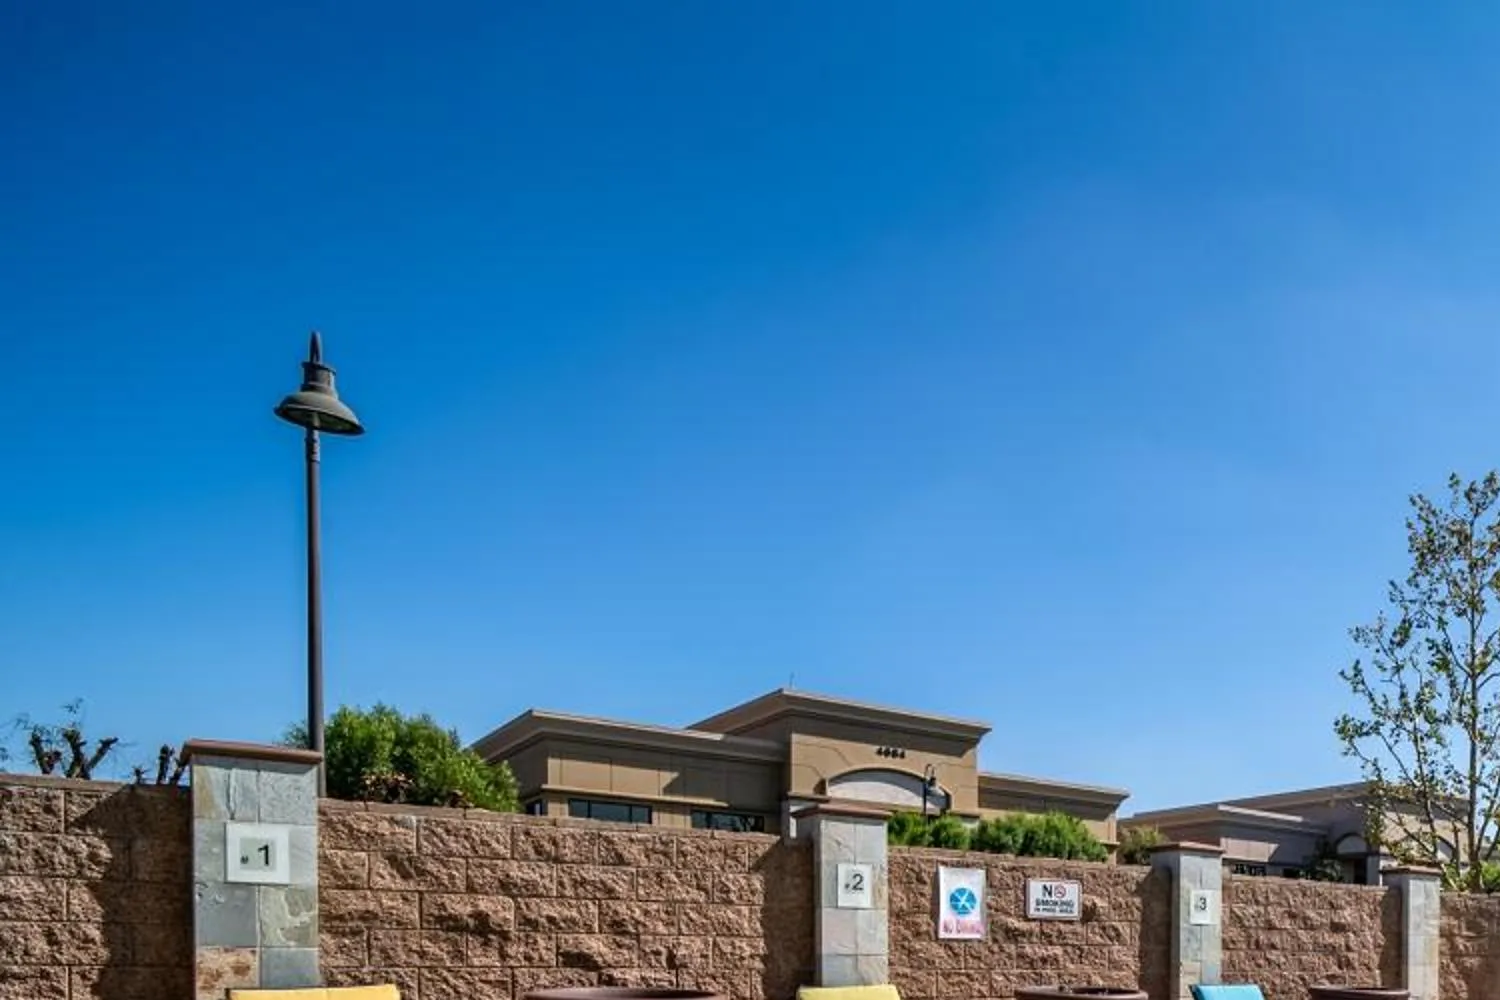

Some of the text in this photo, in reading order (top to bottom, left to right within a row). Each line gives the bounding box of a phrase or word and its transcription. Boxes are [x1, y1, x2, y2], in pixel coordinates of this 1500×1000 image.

[257, 844, 269, 867] 1
[852, 873, 864, 890] 2
[1036, 899, 1074, 908] SMOKING
[1200, 896, 1207, 911] 3
